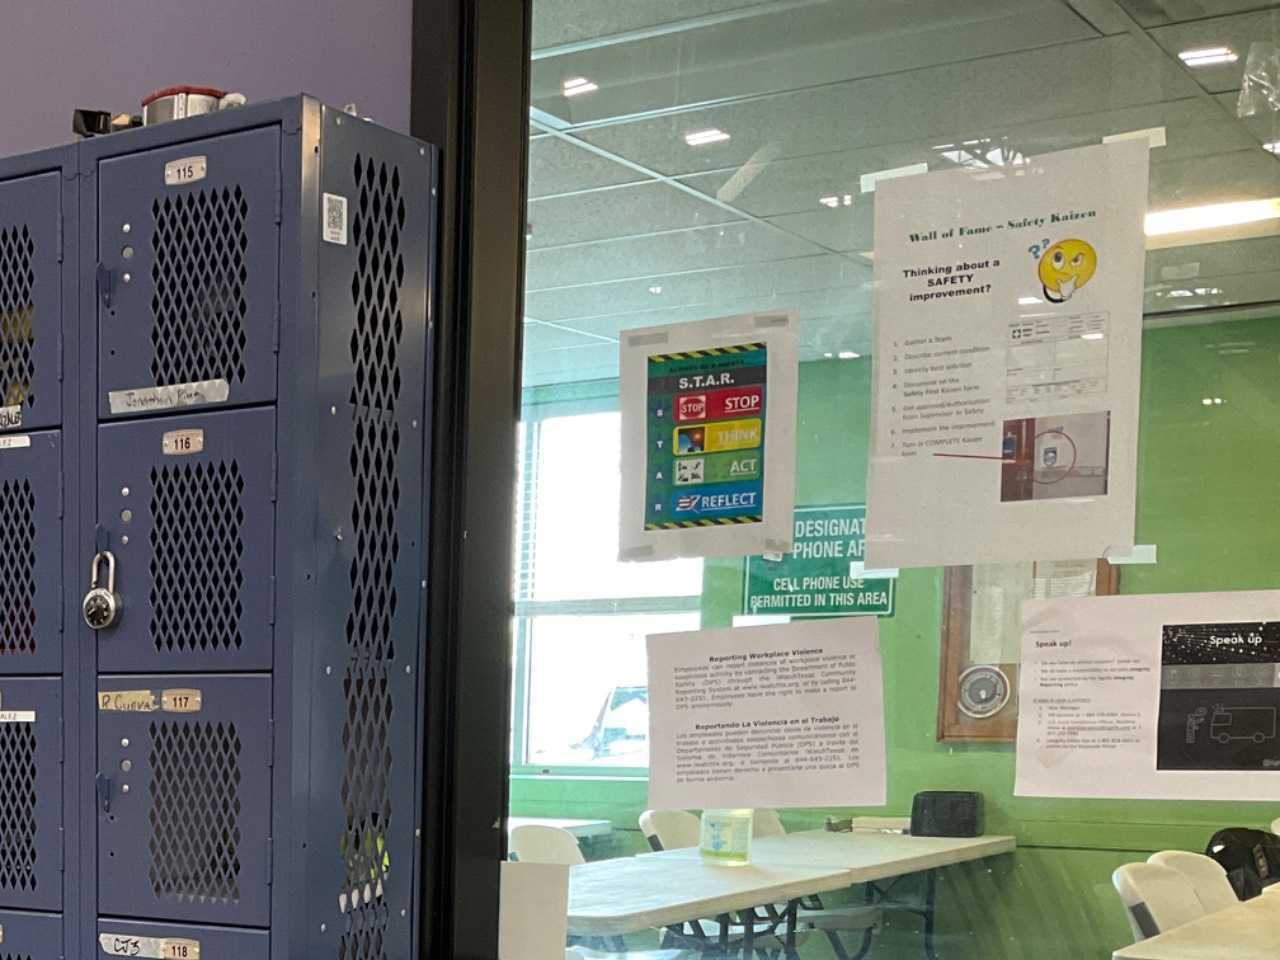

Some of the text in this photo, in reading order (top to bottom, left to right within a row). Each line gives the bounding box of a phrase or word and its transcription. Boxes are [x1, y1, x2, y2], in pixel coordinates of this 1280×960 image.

[177, 166, 193, 179] 115
[909, 231, 937, 242] Wall
[941, 229, 954, 239] of
[959, 226, 992, 236] Fame
[1007, 214, 1046, 229] Safety
[1050, 210, 1097, 223] Kaizen
[903, 265, 952, 279] Thinking
[956, 260, 989, 272] about
[927, 273, 975, 287] SAFETY
[909, 284, 991, 302] improvement?
[679, 372, 735, 389] S.T.A.R.
[681, 395, 760, 413] STOP STOP
[174, 437, 190, 449] 116
[719, 429, 758, 444] THINK
[730, 459, 757, 473] ACT
[701, 492, 757, 508] REFLECT
[795, 519, 865, 538] DESIGNAT
[793, 540, 843, 559] PHONE
[773, 576, 864, 592] CELL PHONE USE
[750, 592, 888, 608] PERMITTED IN THIS AREA
[1210, 634, 1263, 648] Speak up
[709, 648, 823, 663] Reporting Workplace Violence
[173, 697, 188, 708] 117
[172, 946, 187, 957] 118
